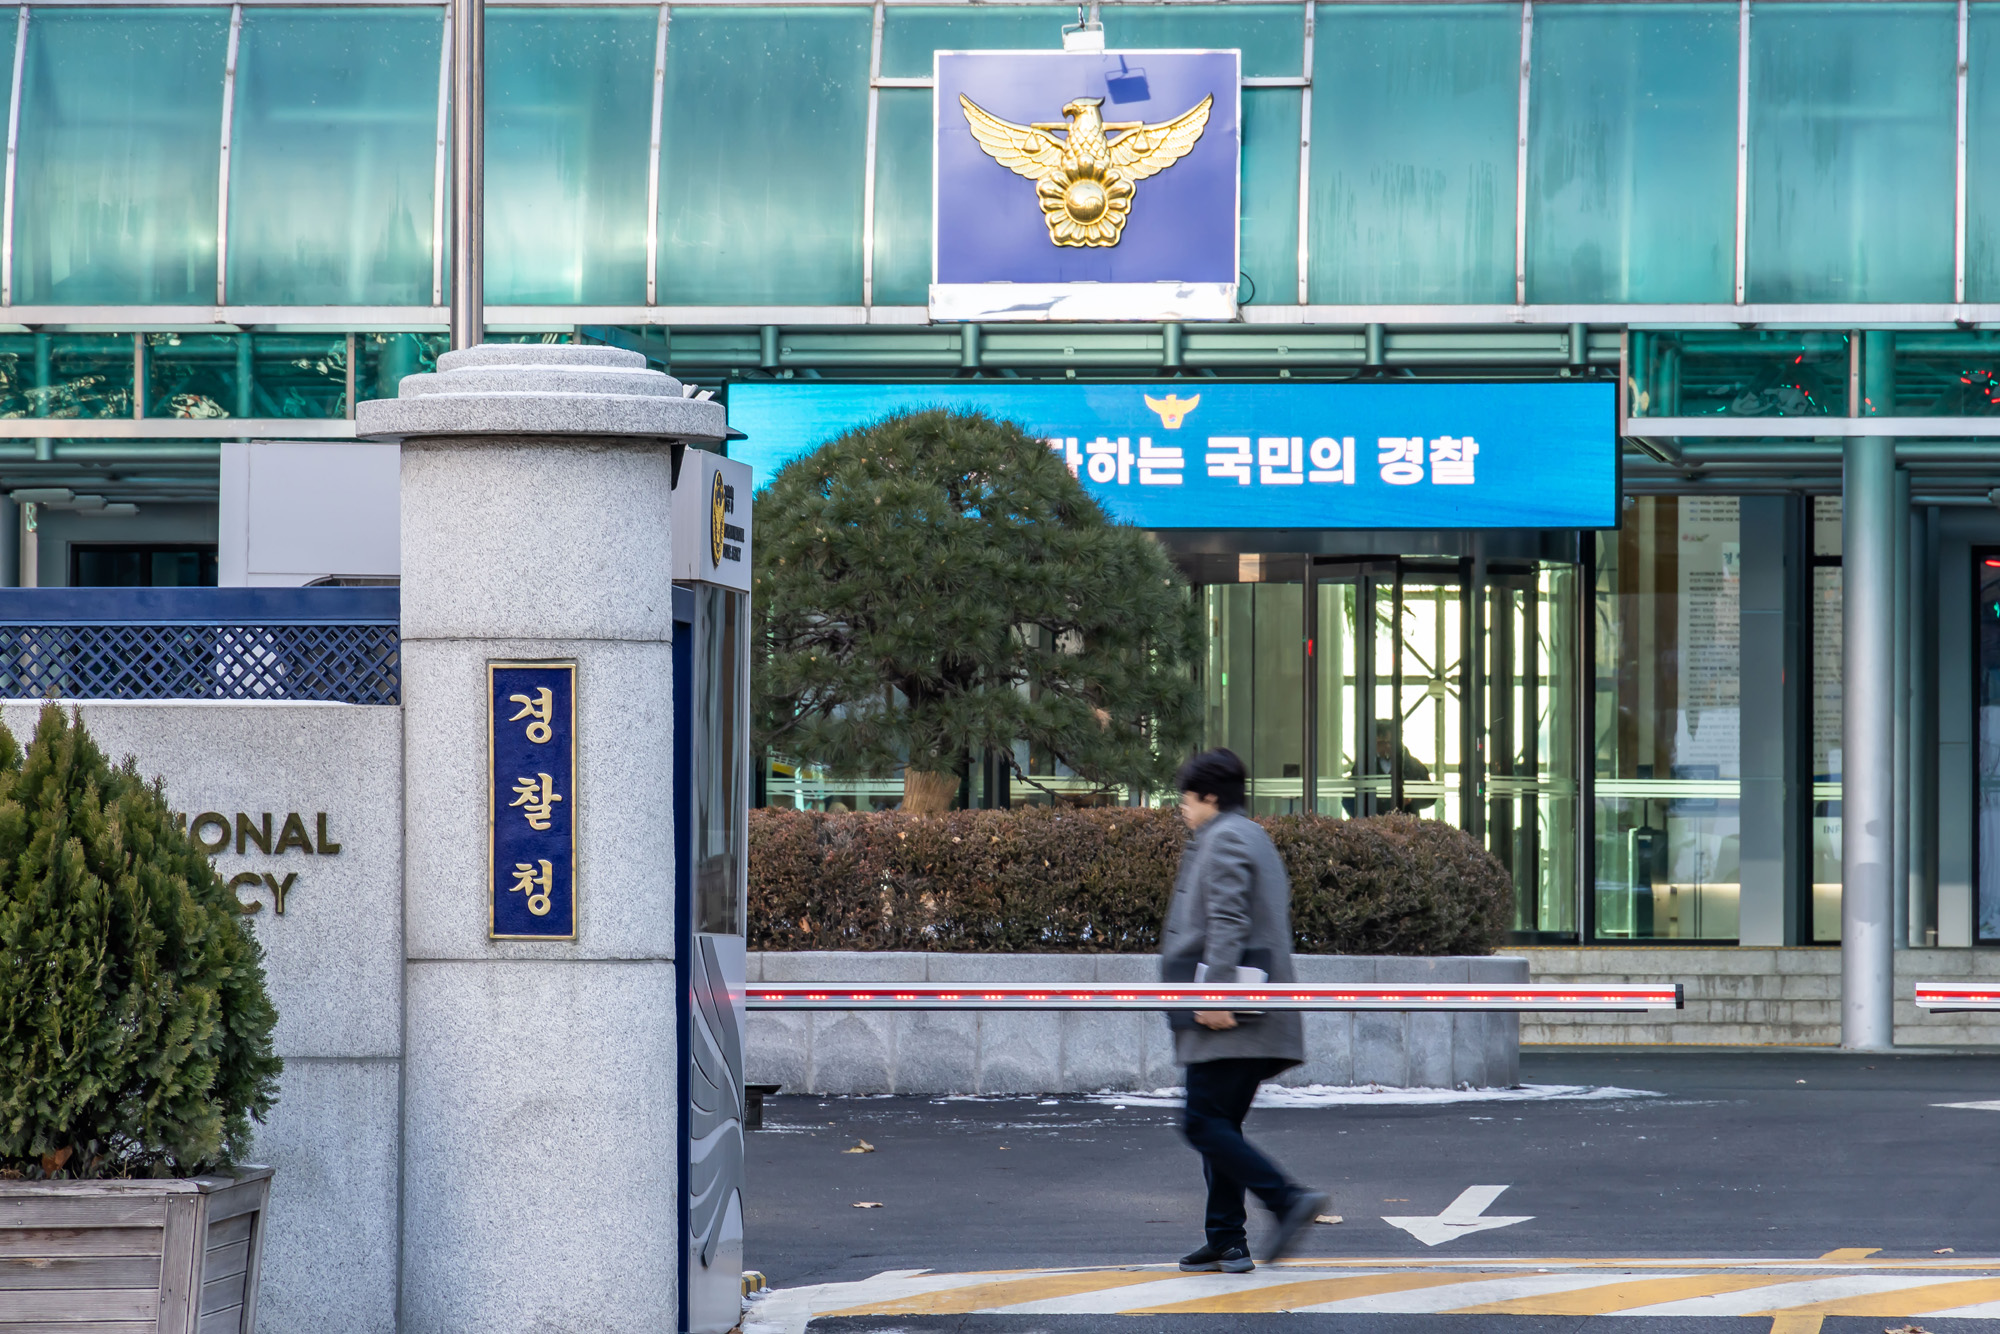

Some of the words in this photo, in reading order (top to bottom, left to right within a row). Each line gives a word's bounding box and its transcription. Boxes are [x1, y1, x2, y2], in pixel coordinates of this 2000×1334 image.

[1205, 436, 1356, 485] 국민의
[1378, 436, 1480, 485] 경찰
[509, 687, 562, 917] 경찰청
